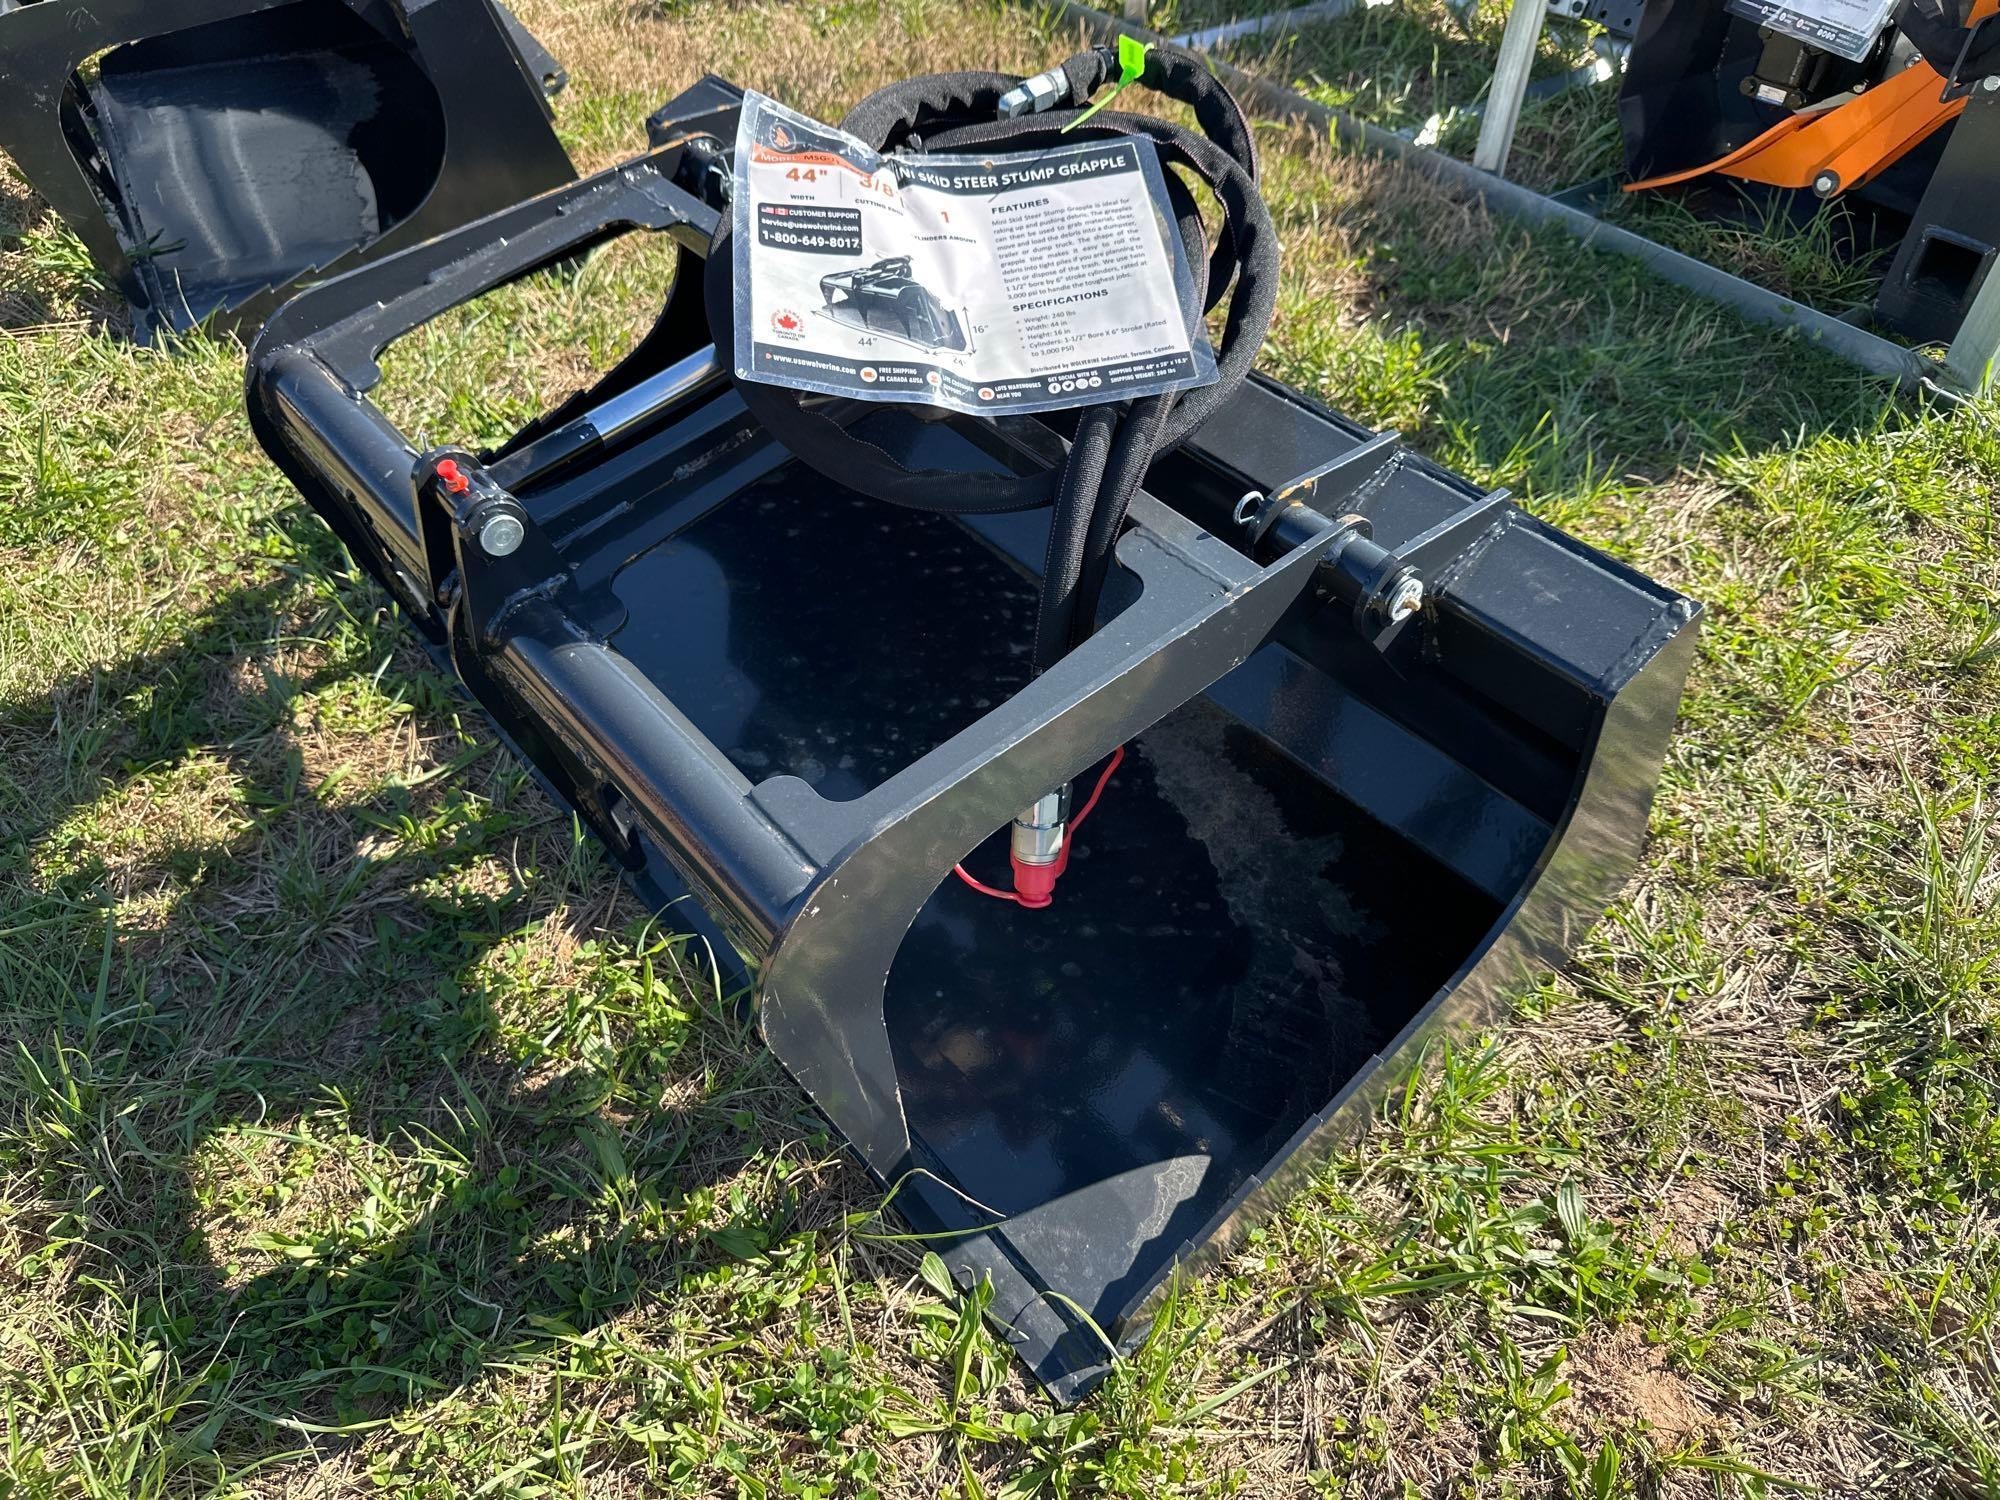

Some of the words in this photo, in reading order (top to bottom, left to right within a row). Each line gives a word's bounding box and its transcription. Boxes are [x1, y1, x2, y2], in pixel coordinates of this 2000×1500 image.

[786, 167, 828, 183] 44"
[899, 166, 916, 179] NI
[918, 172, 950, 188] SKID
[953, 176, 998, 189] STEER
[1002, 168, 1055, 185] STUMP
[1058, 155, 1126, 176] GRAPPLE
[860, 175, 894, 197] 3/8
[789, 209, 826, 218] CUSTOMER
[827, 210, 859, 219] SUPPORT
[991, 198, 1050, 215] FEATURES
[992, 218, 1006, 226] Mini
[1024, 212, 1041, 220] Steer
[1043, 208, 1065, 218] Stump
[1067, 203, 1092, 214] Grapple
[761, 218, 859, 232] service@usawolverine.com
[941, 211, 949, 224] 1
[993, 226, 1013, 235] raking
[1039, 216, 1065, 227] pushing
[1104, 204, 1132, 215] grapples
[762, 230, 860, 249] 1-800-649-8017
[949, 235, 977, 244] AMOUNT
[1009, 232, 1024, 240] then
[1067, 221, 1082, 230] grab
[1060, 230, 1080, 239] debris
[998, 250, 1018, 259] trailer
[1032, 244, 1052, 254] dump
[1093, 232, 1113, 242] shape
[1000, 257, 1025, 268] grapple
[1047, 249, 1068, 258] makes
[1002, 266, 1022, 275] debris
[1024, 263, 1037, 271] into
[1056, 257, 1071, 266] piles
[1105, 245, 1134, 256] planning
[1003, 275, 1020, 283] burn
[1031, 268, 1056, 279] dispose
[1129, 251, 1144, 259] twin
[1028, 279, 1043, 287] bore
[1065, 271, 1085, 280] stroke
[1120, 261, 1138, 269] rated
[1027, 289, 1037, 297] psi
[1047, 283, 1070, 292] handle
[1084, 274, 1114, 286] toughest
[1012, 288, 1109, 312] SPECIFICATIONS
[1023, 313, 1050, 324] Weight:
[1025, 322, 1049, 331] Width:
[973, 325, 989, 334] 16"
[1027, 330, 1052, 341] Height:
[1029, 337, 1062, 349] Cylinders:
[1087, 330, 1103, 338] Bore
[1120, 323, 1142, 332] Stroke
[1144, 318, 1166, 327] (Rated
[857, 337, 878, 347] 44"
[773, 354, 856, 375] www.usawolverine.com
[1030, 364, 1061, 373] Distributed
[1070, 357, 1100, 366] WOLVERINE
[1153, 344, 1174, 353] Canada
[892, 367, 917, 375] SHIPPING
[1108, 367, 1131, 375] SHIPPING
[1110, 374, 1134, 383] SHIPPING
[1008, 382, 1041, 390] WAREHOUSES
